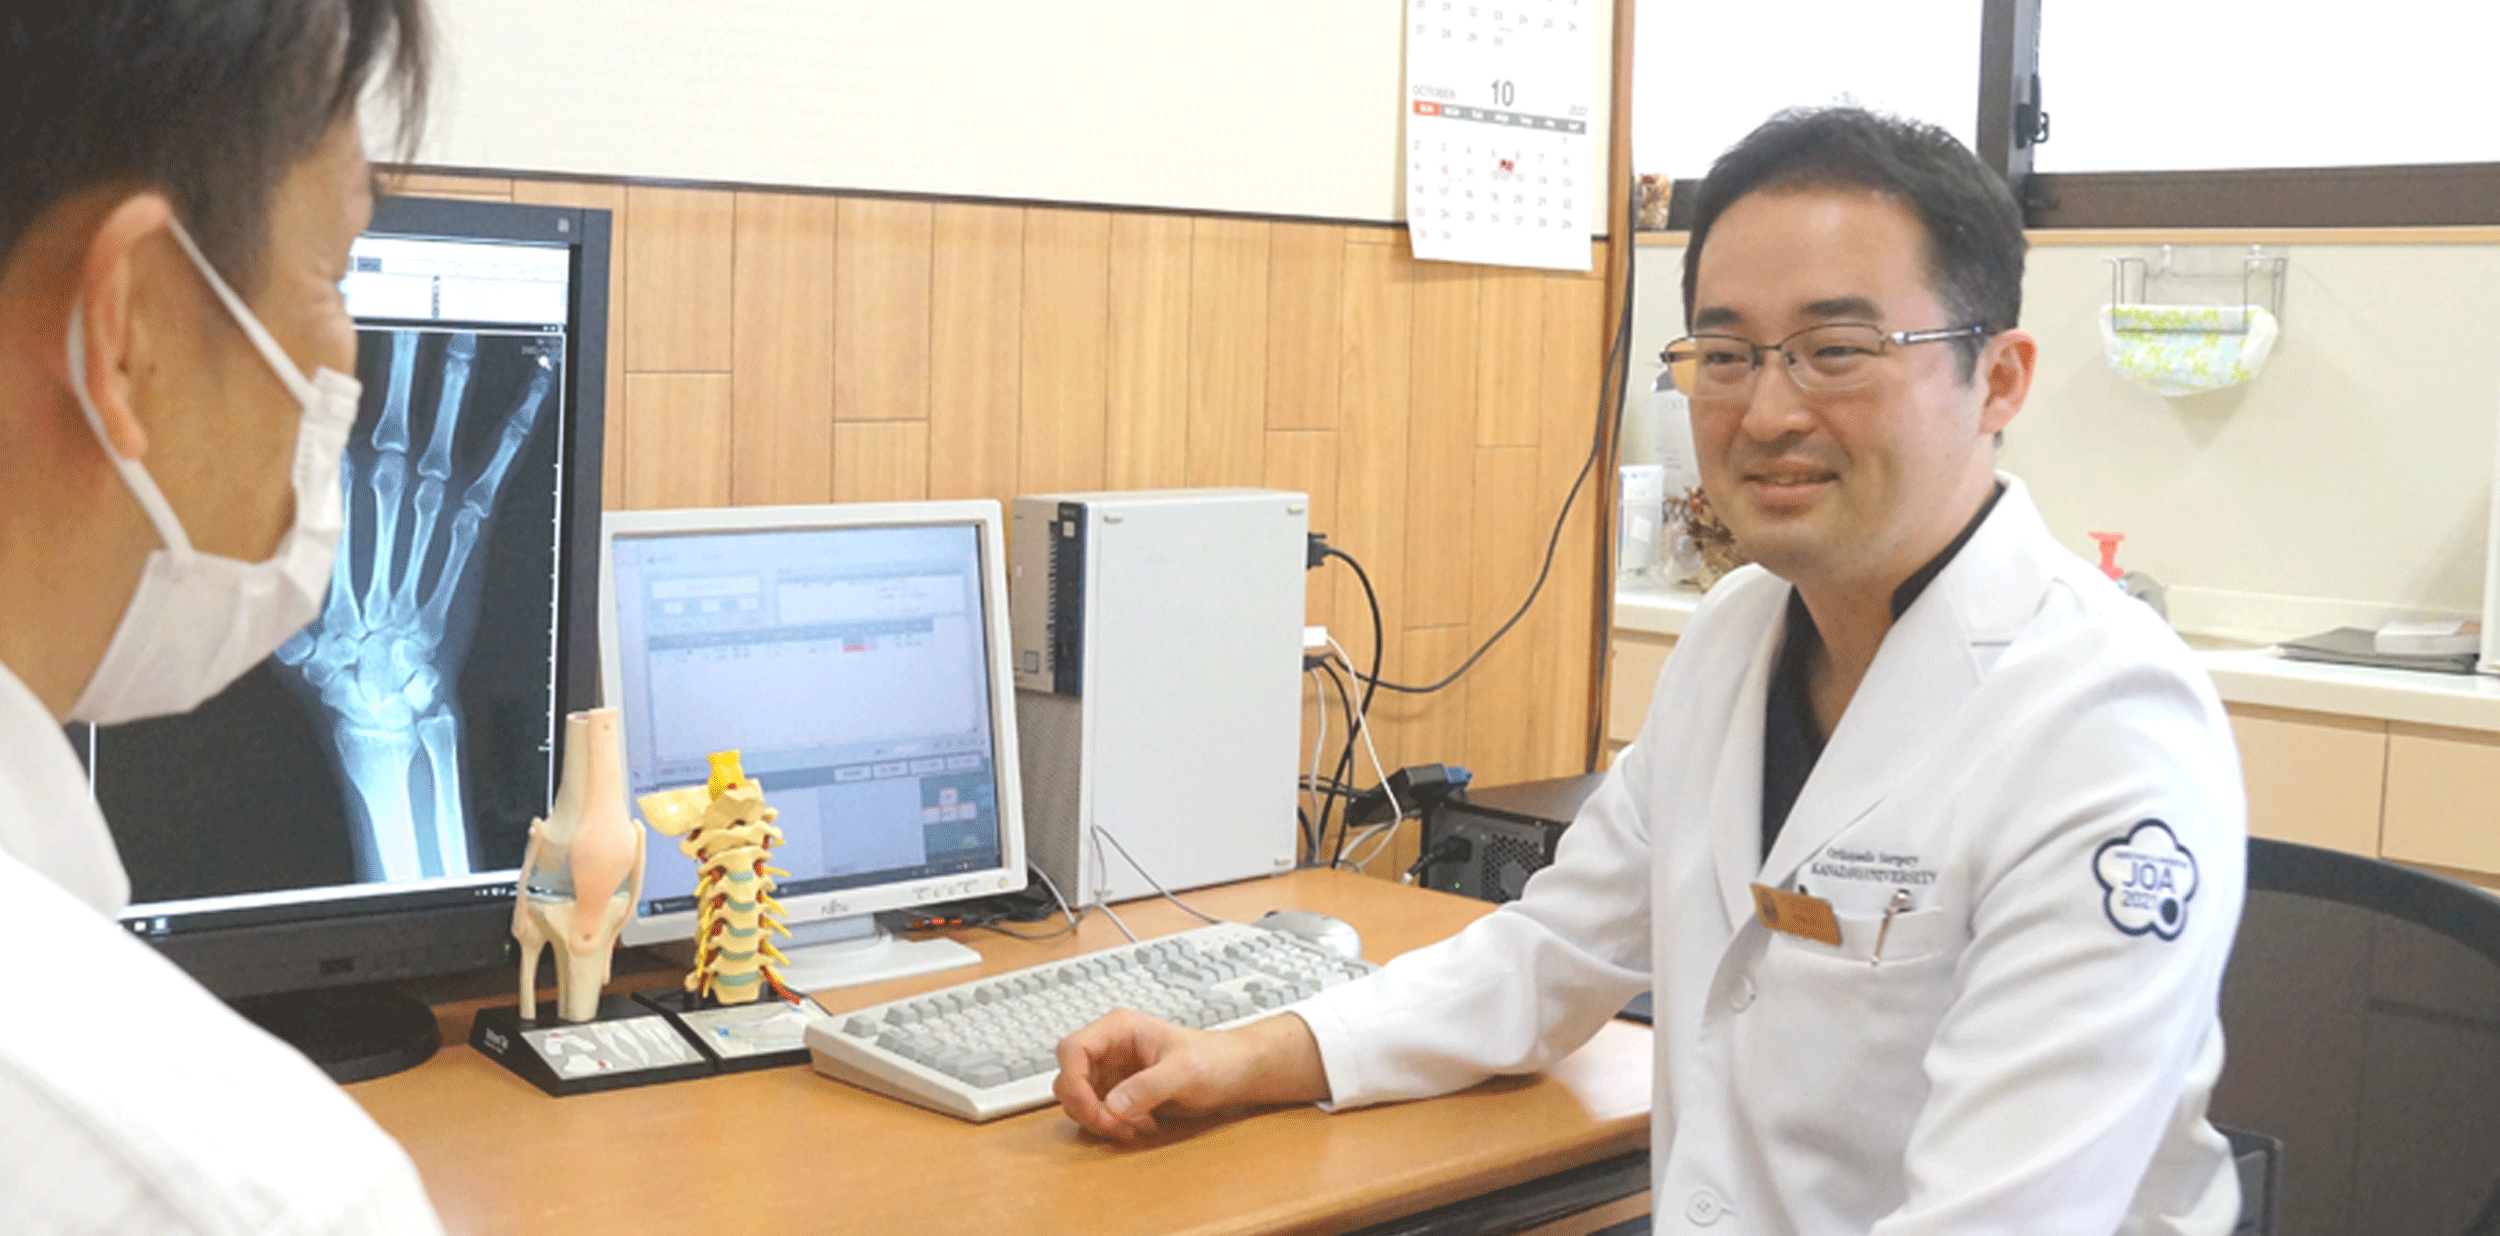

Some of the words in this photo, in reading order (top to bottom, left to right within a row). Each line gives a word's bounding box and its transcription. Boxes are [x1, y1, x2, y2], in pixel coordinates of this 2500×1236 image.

[1412, 84, 1456, 99] OCTOBER
[1491, 79, 1515, 108] 10
[2122, 861, 2176, 894] JOA
